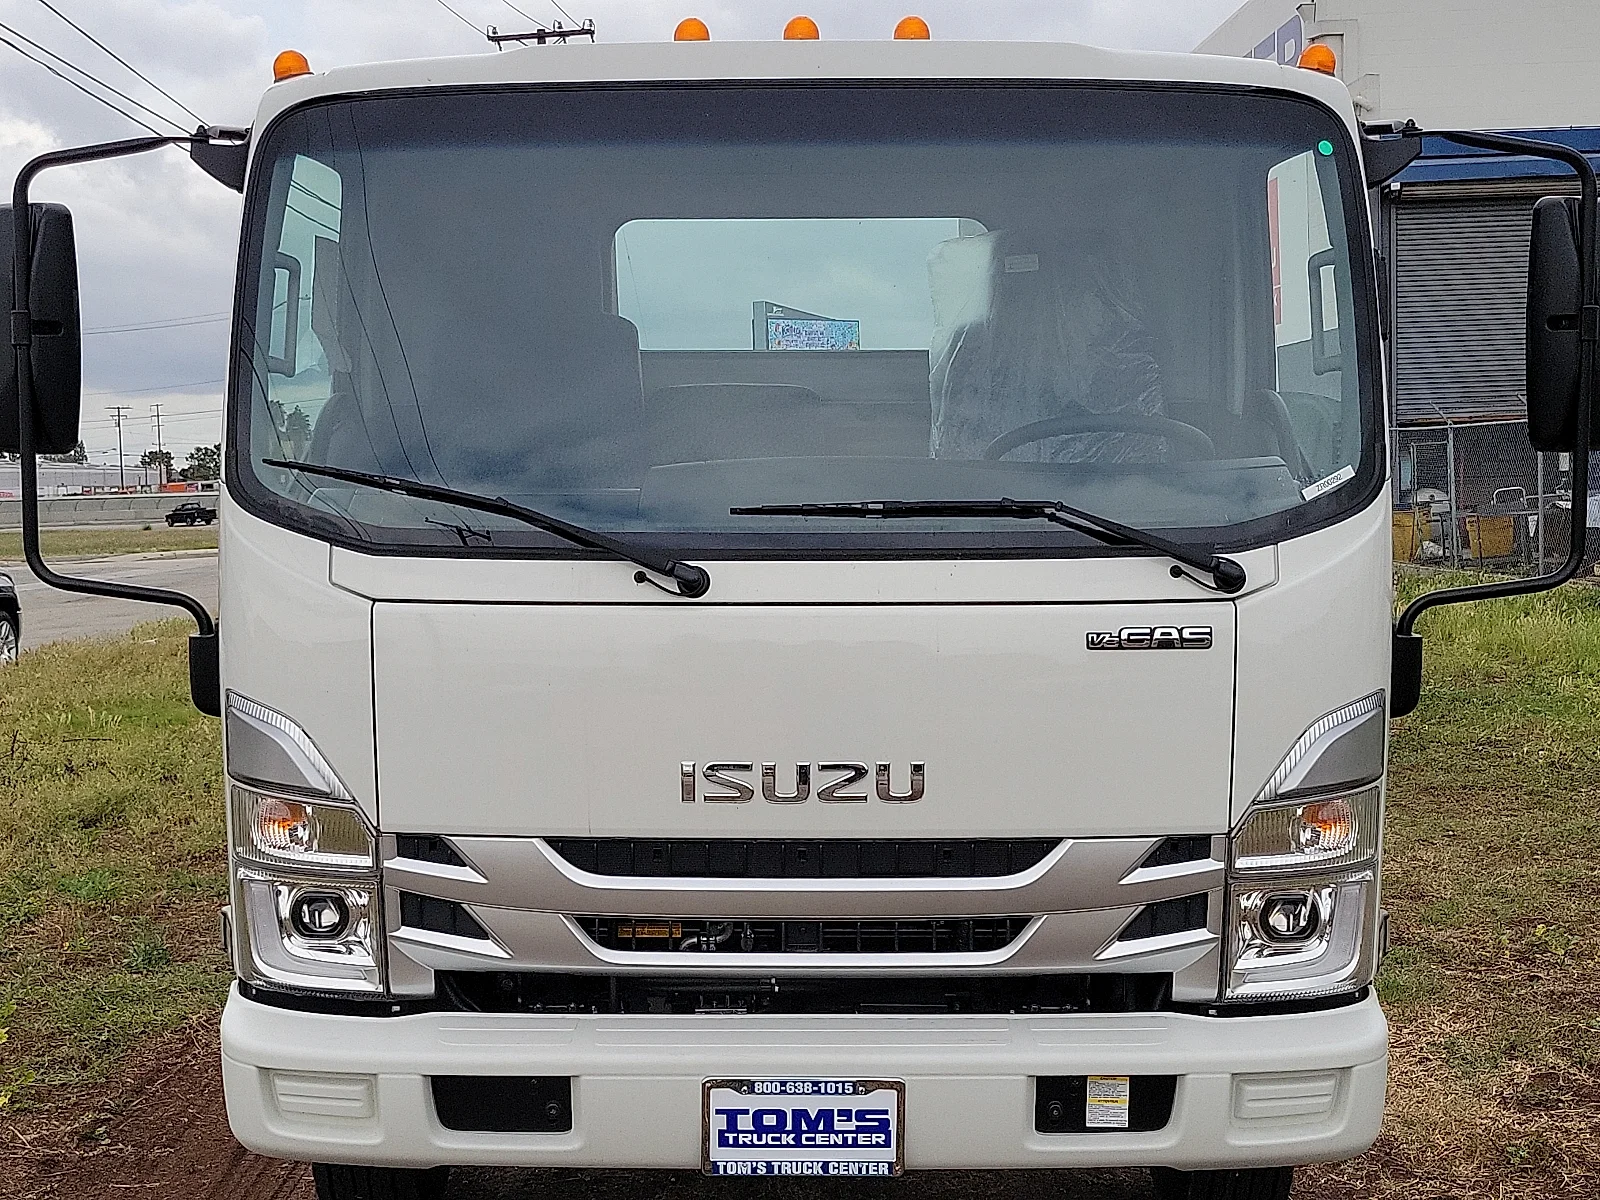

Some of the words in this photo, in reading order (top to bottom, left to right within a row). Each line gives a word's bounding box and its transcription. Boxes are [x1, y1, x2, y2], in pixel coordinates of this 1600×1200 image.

[1120, 627, 1211, 648] GAS
[680, 761, 926, 804] ISUZU
[754, 1082, 854, 1094] 800-638-1015
[714, 1108, 891, 1131] TOM'S
[724, 1132, 796, 1145] TRUCK
[801, 1132, 886, 1145] CENTER
[717, 1162, 767, 1175] TOM'S
[771, 1162, 824, 1175] TRUCK
[828, 1162, 889, 1175] CENTER
